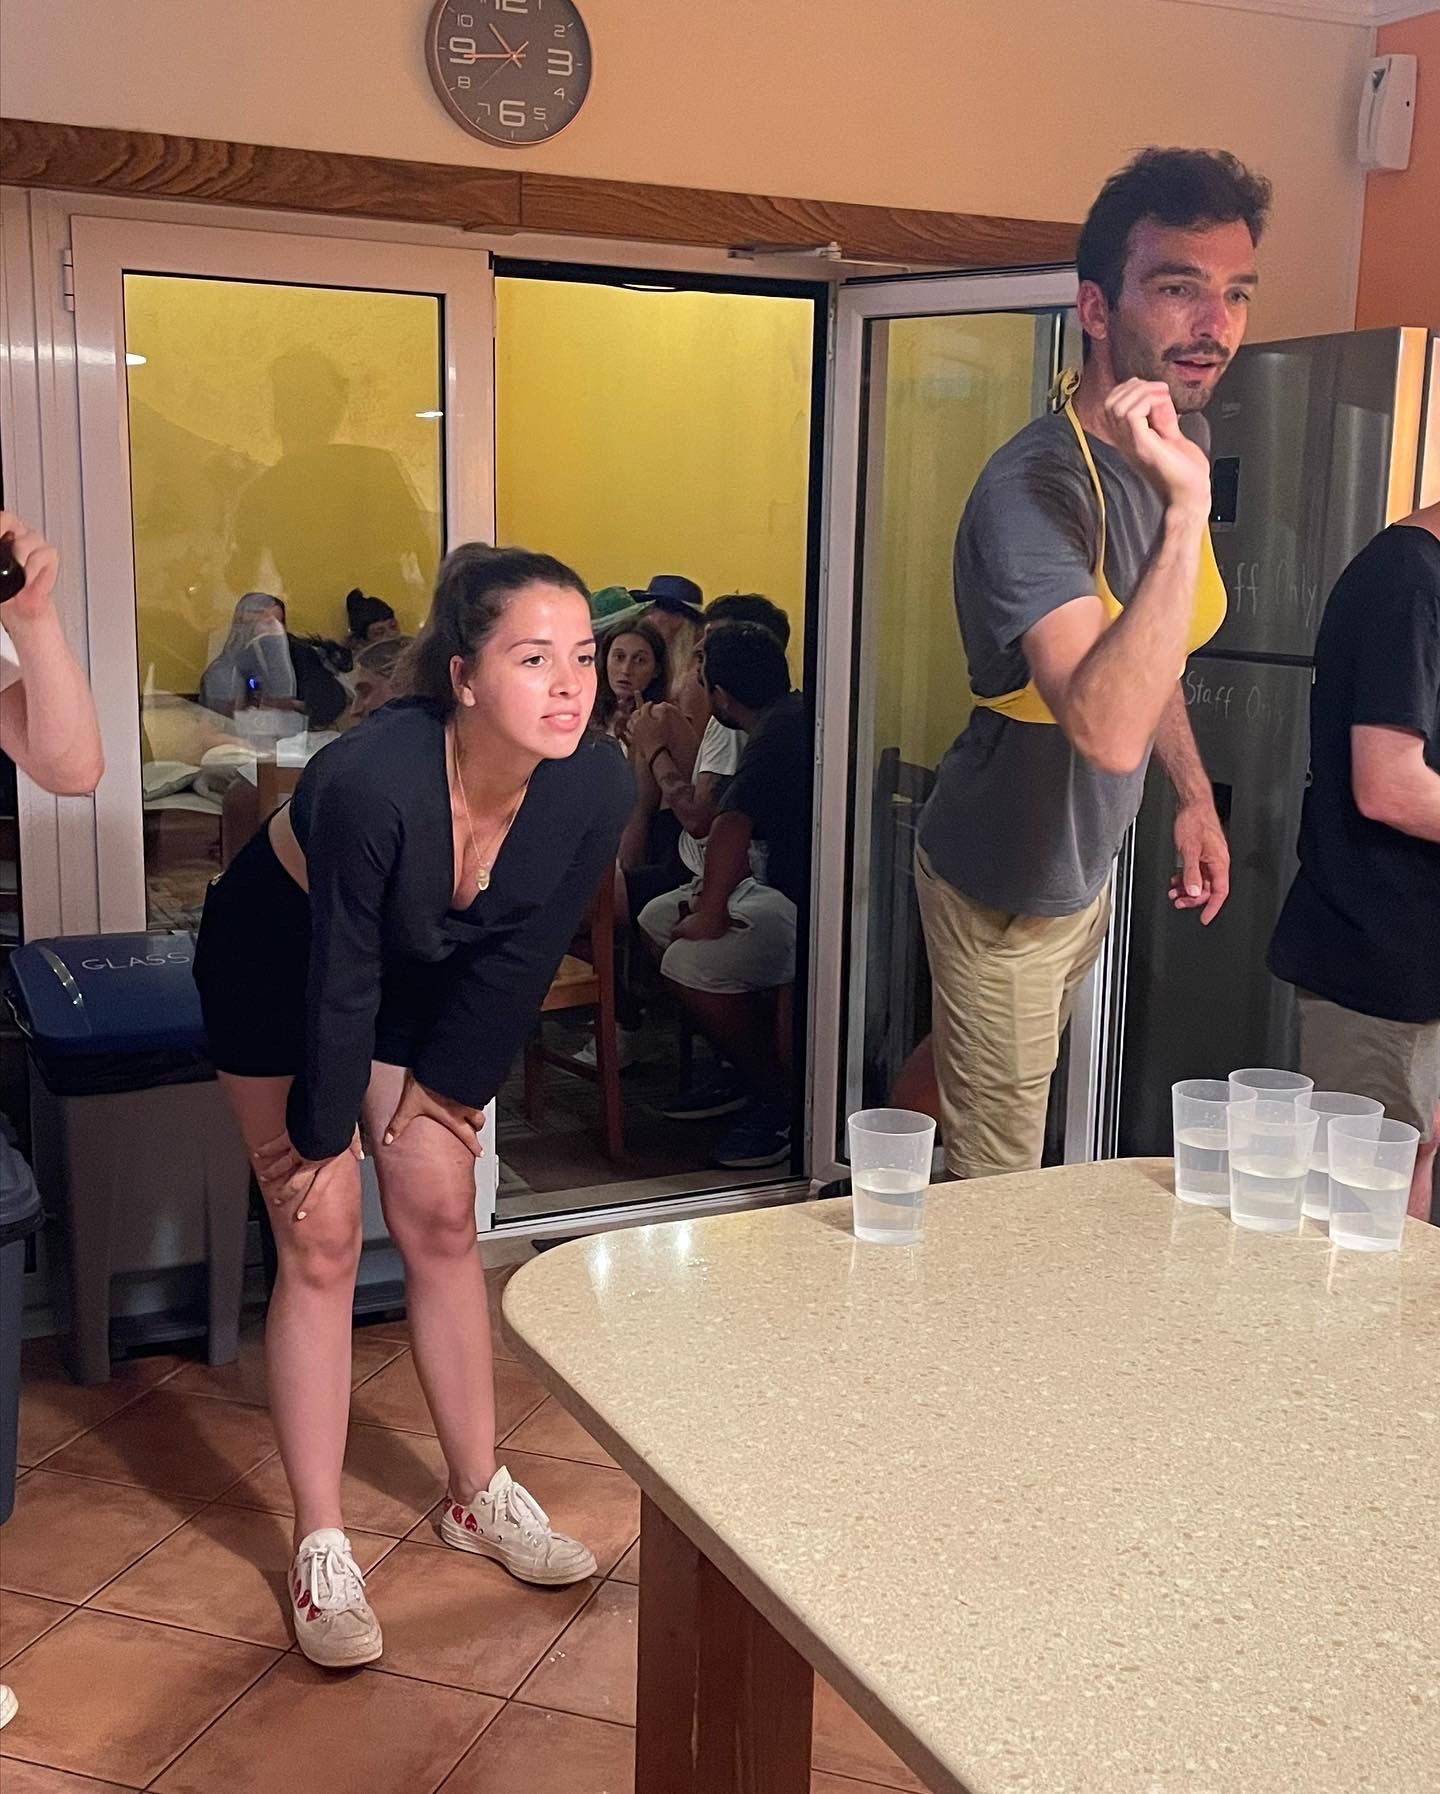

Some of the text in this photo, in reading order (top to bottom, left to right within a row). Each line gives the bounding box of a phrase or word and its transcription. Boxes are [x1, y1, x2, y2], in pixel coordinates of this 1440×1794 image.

[457, 14, 473, 28] 10
[553, 24, 566, 38] 2
[449, 37, 476, 65] 9
[547, 48, 573, 76] 3
[457, 76, 471, 89] 8
[553, 87, 565, 100] 4
[477, 102, 491, 116] 7
[499, 100, 526, 127] 6
[533, 107, 546, 121] 5
[1185, 670, 1235, 719] Staff
[82, 951, 190, 970] GLASS
